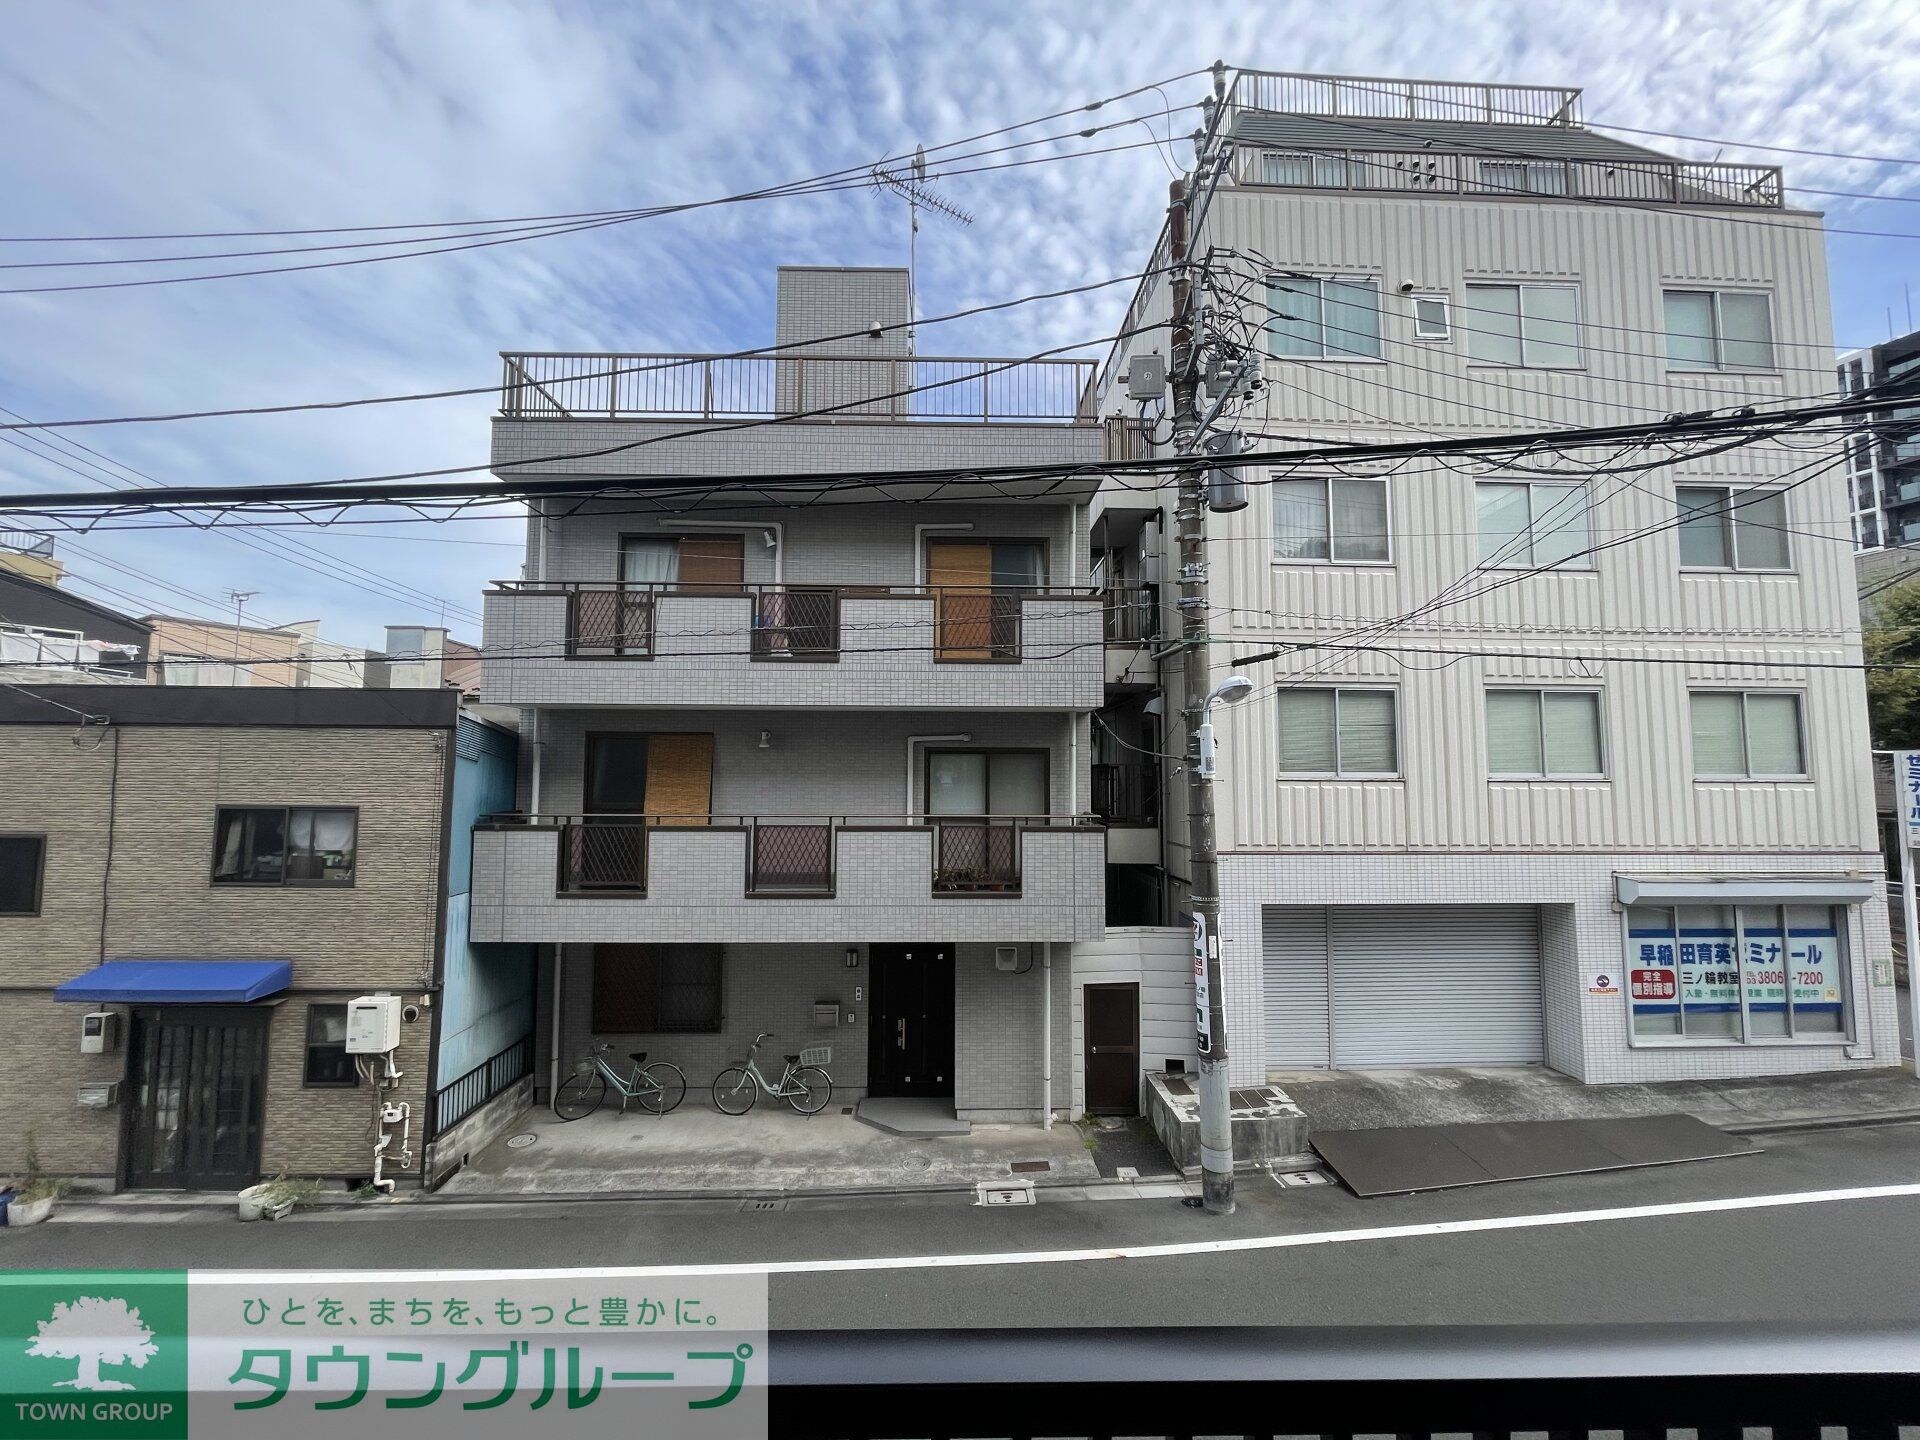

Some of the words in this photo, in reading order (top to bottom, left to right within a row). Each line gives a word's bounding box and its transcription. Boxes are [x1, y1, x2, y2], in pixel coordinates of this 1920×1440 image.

[1642, 971, 1661, 981] 完全
[1682, 971, 1739, 985] 三ノ輪教室
[1758, 971, 1823, 985] 3806-7200
[1632, 982, 1674, 996] 個別指導
